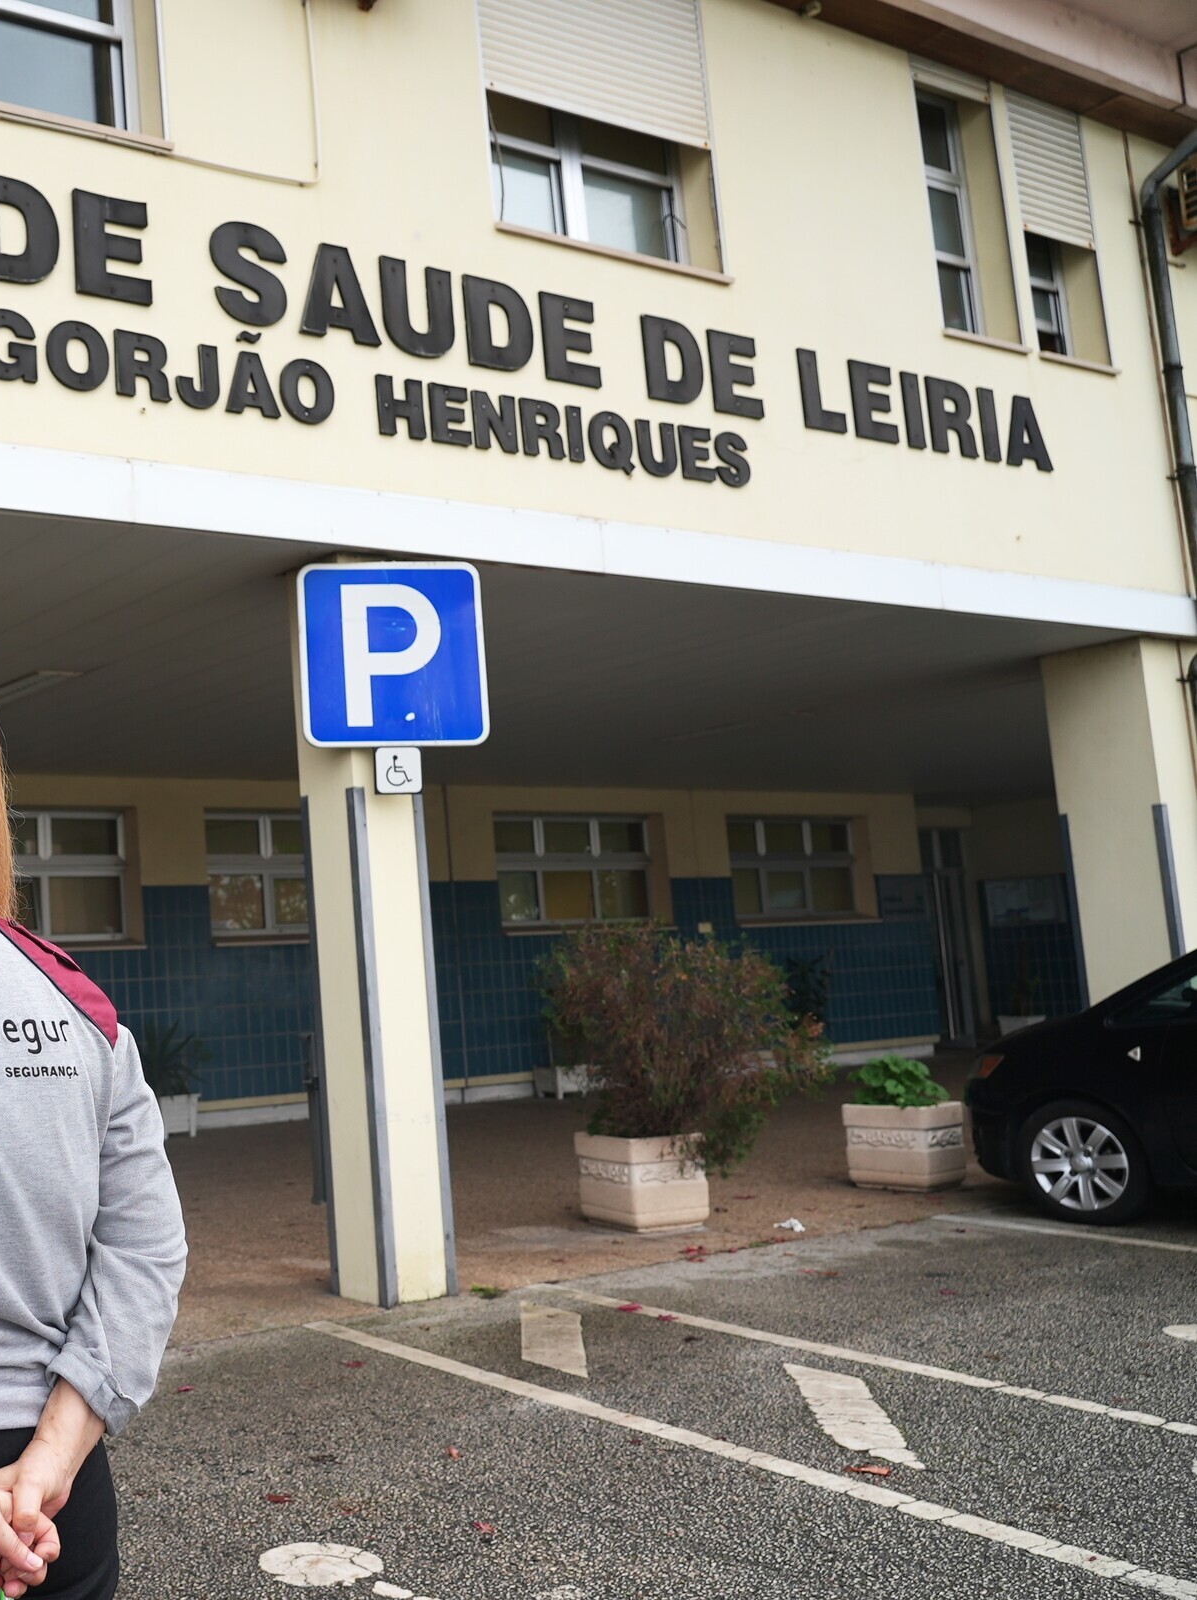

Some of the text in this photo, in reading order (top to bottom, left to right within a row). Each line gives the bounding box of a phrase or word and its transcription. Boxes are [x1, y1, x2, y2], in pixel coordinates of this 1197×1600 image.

[209, 221, 601, 389] SAUDE
[641, 314, 764, 419] DE
[796, 348, 1053, 472] LEIRIA
[375, 374, 750, 488] HENRIQUES
[340, 583, 442, 727] P
[5, 1066, 78, 1078] SEGURANÇA
